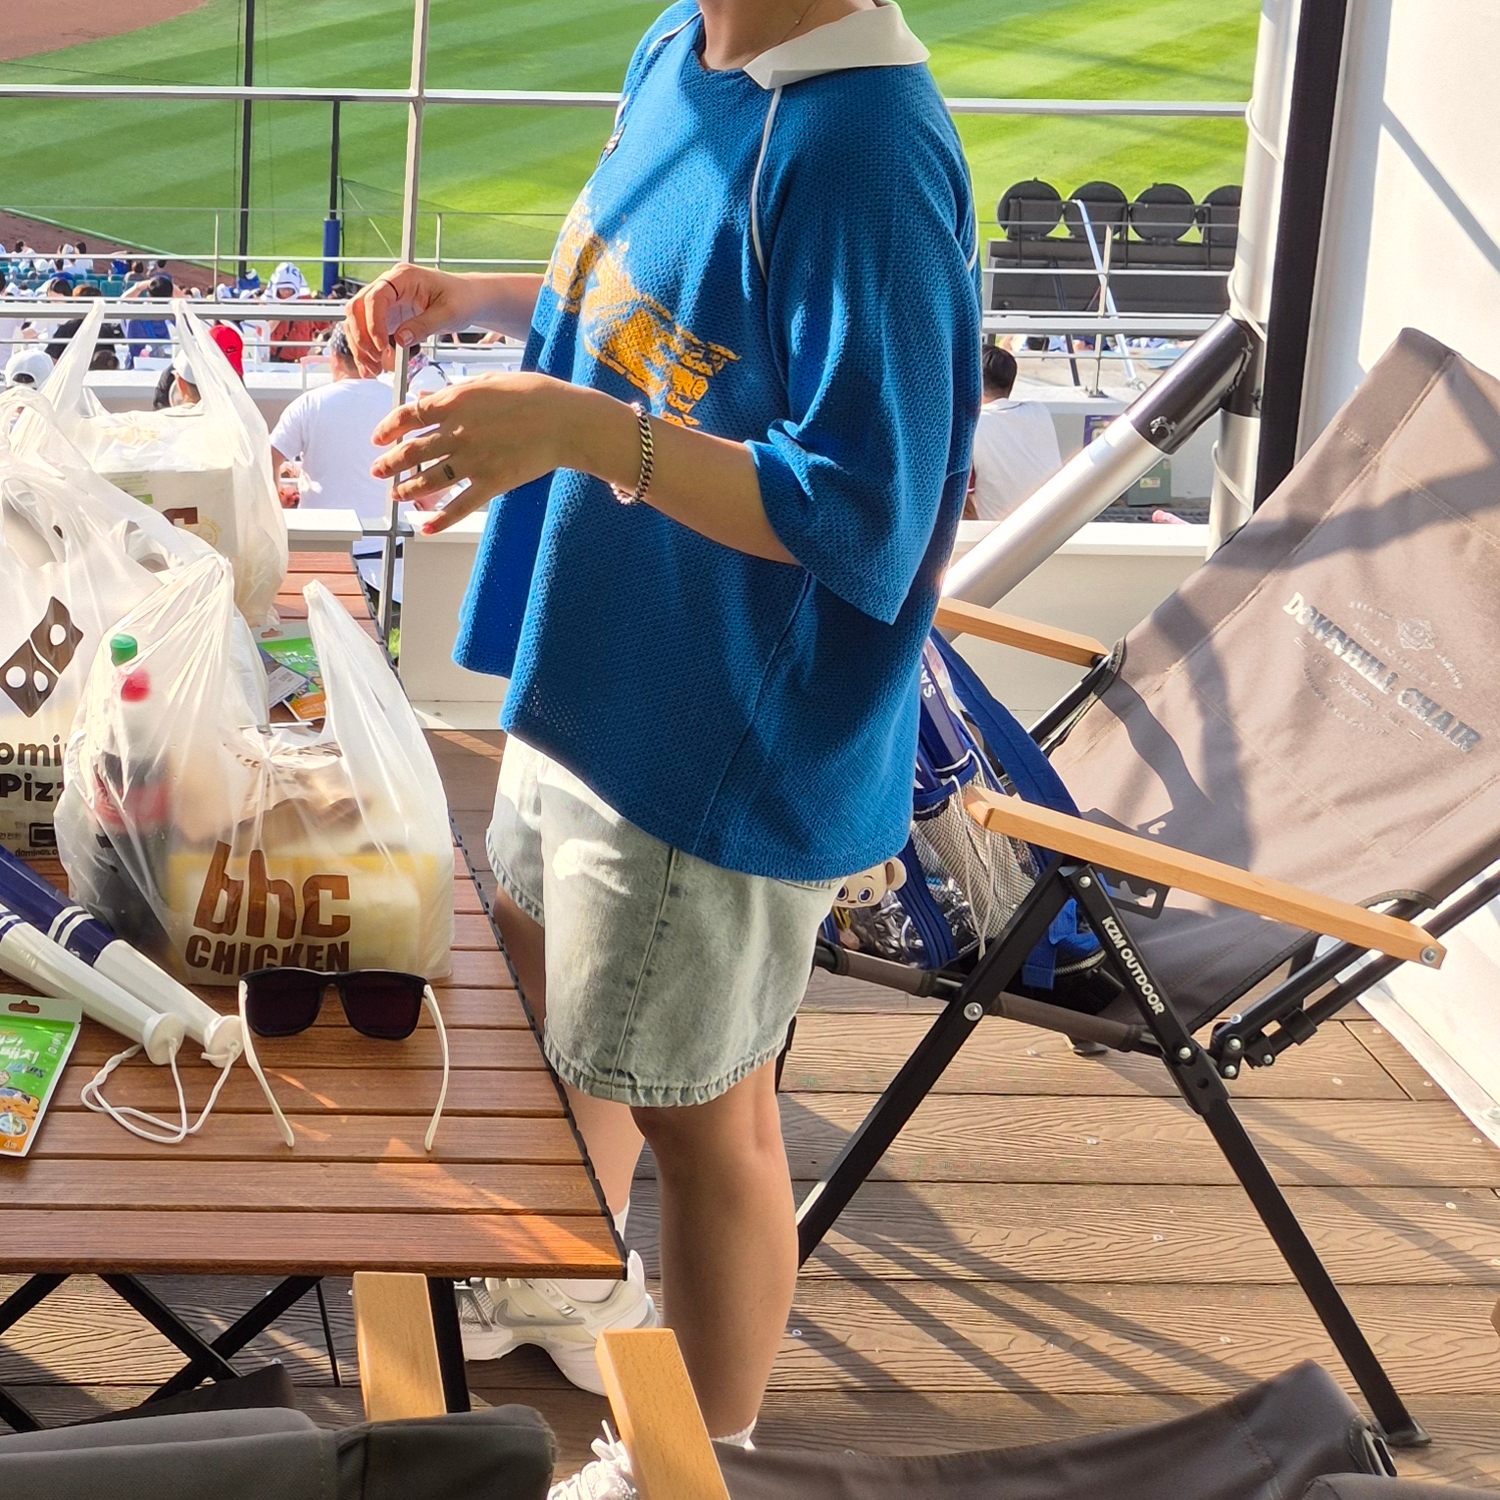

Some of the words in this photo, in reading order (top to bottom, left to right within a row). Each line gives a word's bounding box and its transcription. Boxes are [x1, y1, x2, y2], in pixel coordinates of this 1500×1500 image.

[1282, 591, 1398, 696] DOWNHILL
[1397, 687, 1482, 754] CHAIR
[193, 840, 351, 940] bhc
[1102, 917, 1126, 949] KZM
[1120, 949, 1166, 1016] OUTDOOR
